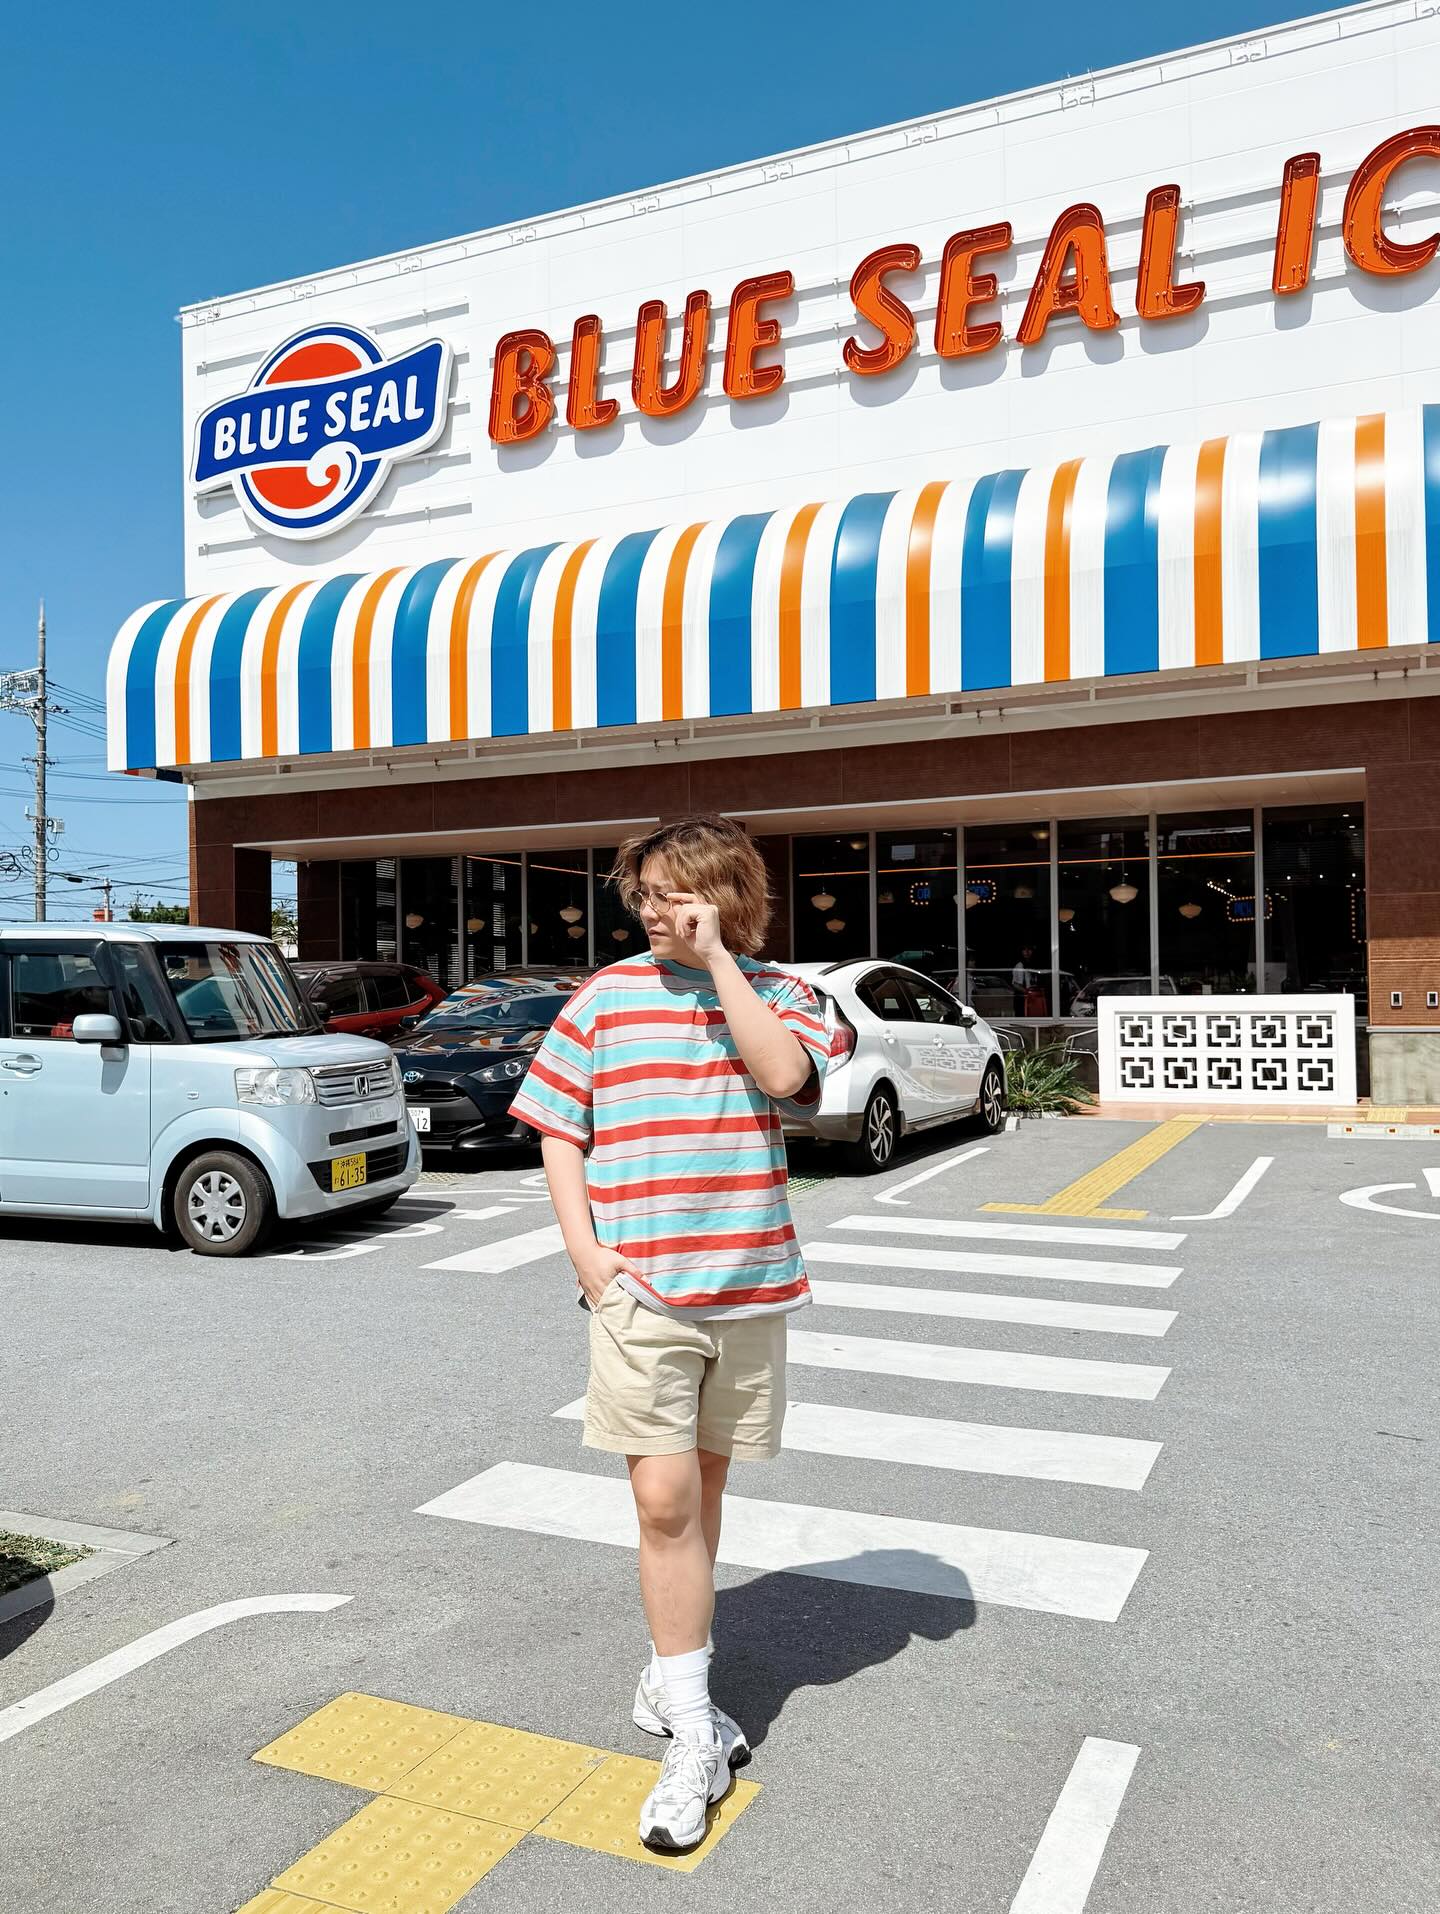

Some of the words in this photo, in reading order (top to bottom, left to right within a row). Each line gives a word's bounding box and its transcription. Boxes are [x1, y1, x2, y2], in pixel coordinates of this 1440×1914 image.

[489, 271, 794, 445] BLUE
[843, 185, 1206, 377] SEAL
[214, 399, 310, 460] BLUE
[324, 375, 425, 437] SEAL
